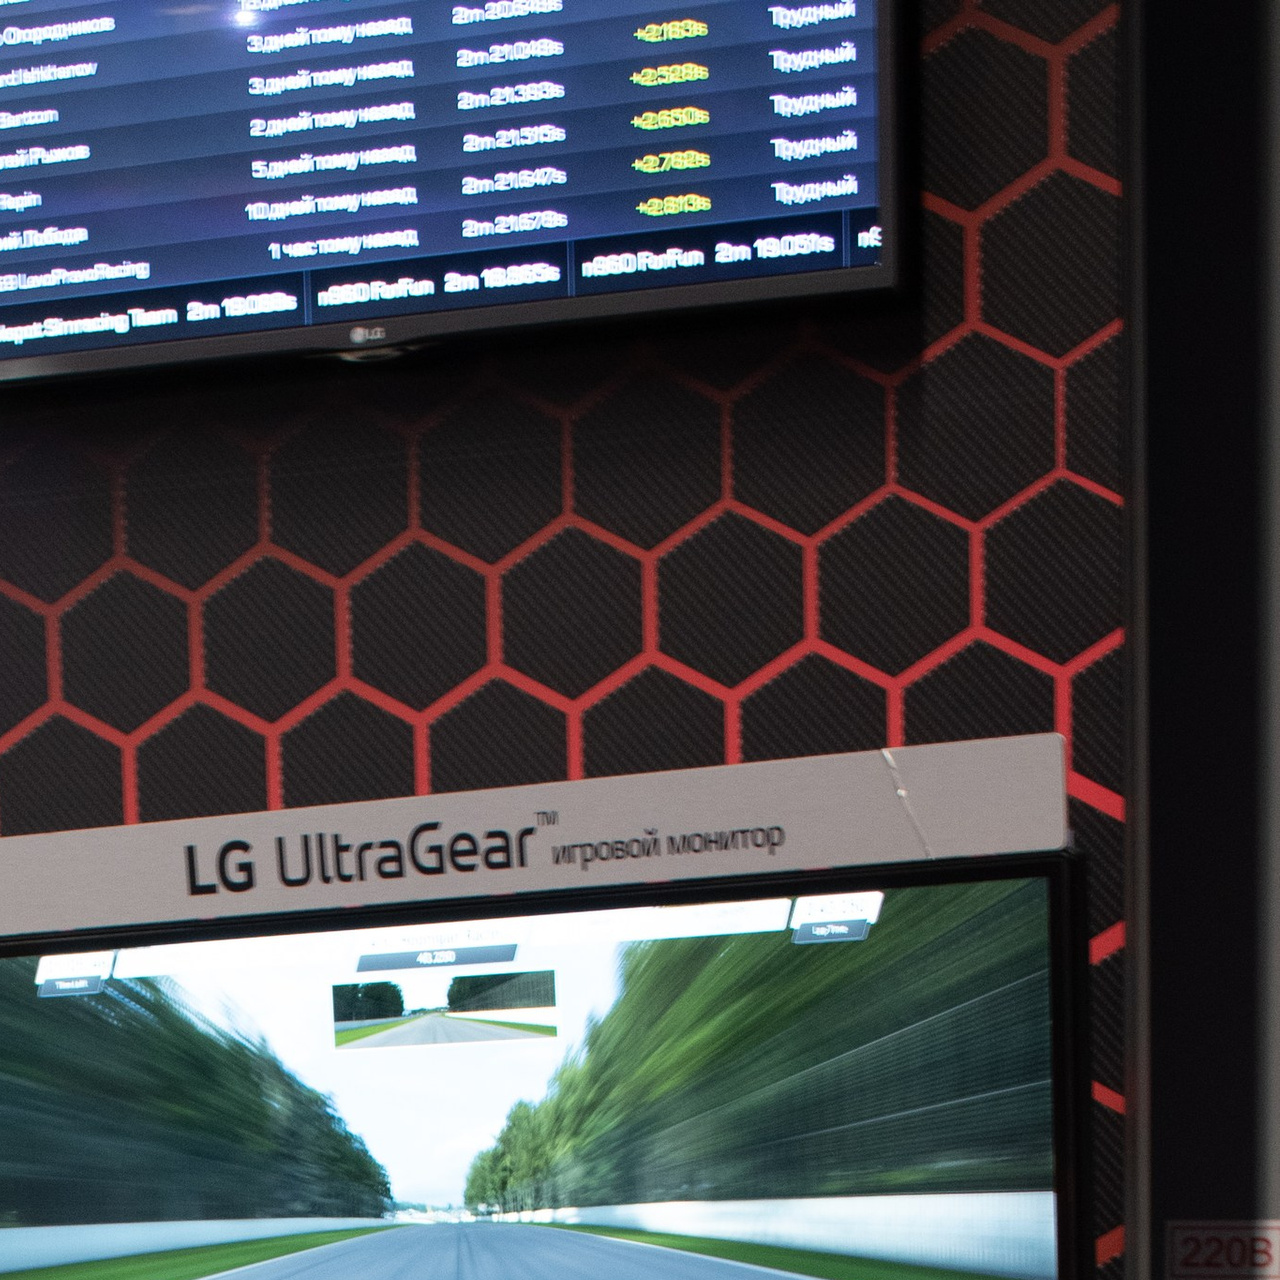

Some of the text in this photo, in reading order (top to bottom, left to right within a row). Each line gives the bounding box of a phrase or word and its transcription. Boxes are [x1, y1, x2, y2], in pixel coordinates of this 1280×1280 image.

[184, 839, 256, 896] LG
[275, 821, 537, 888] UltraGear
[552, 825, 786, 871] игровой монитор
